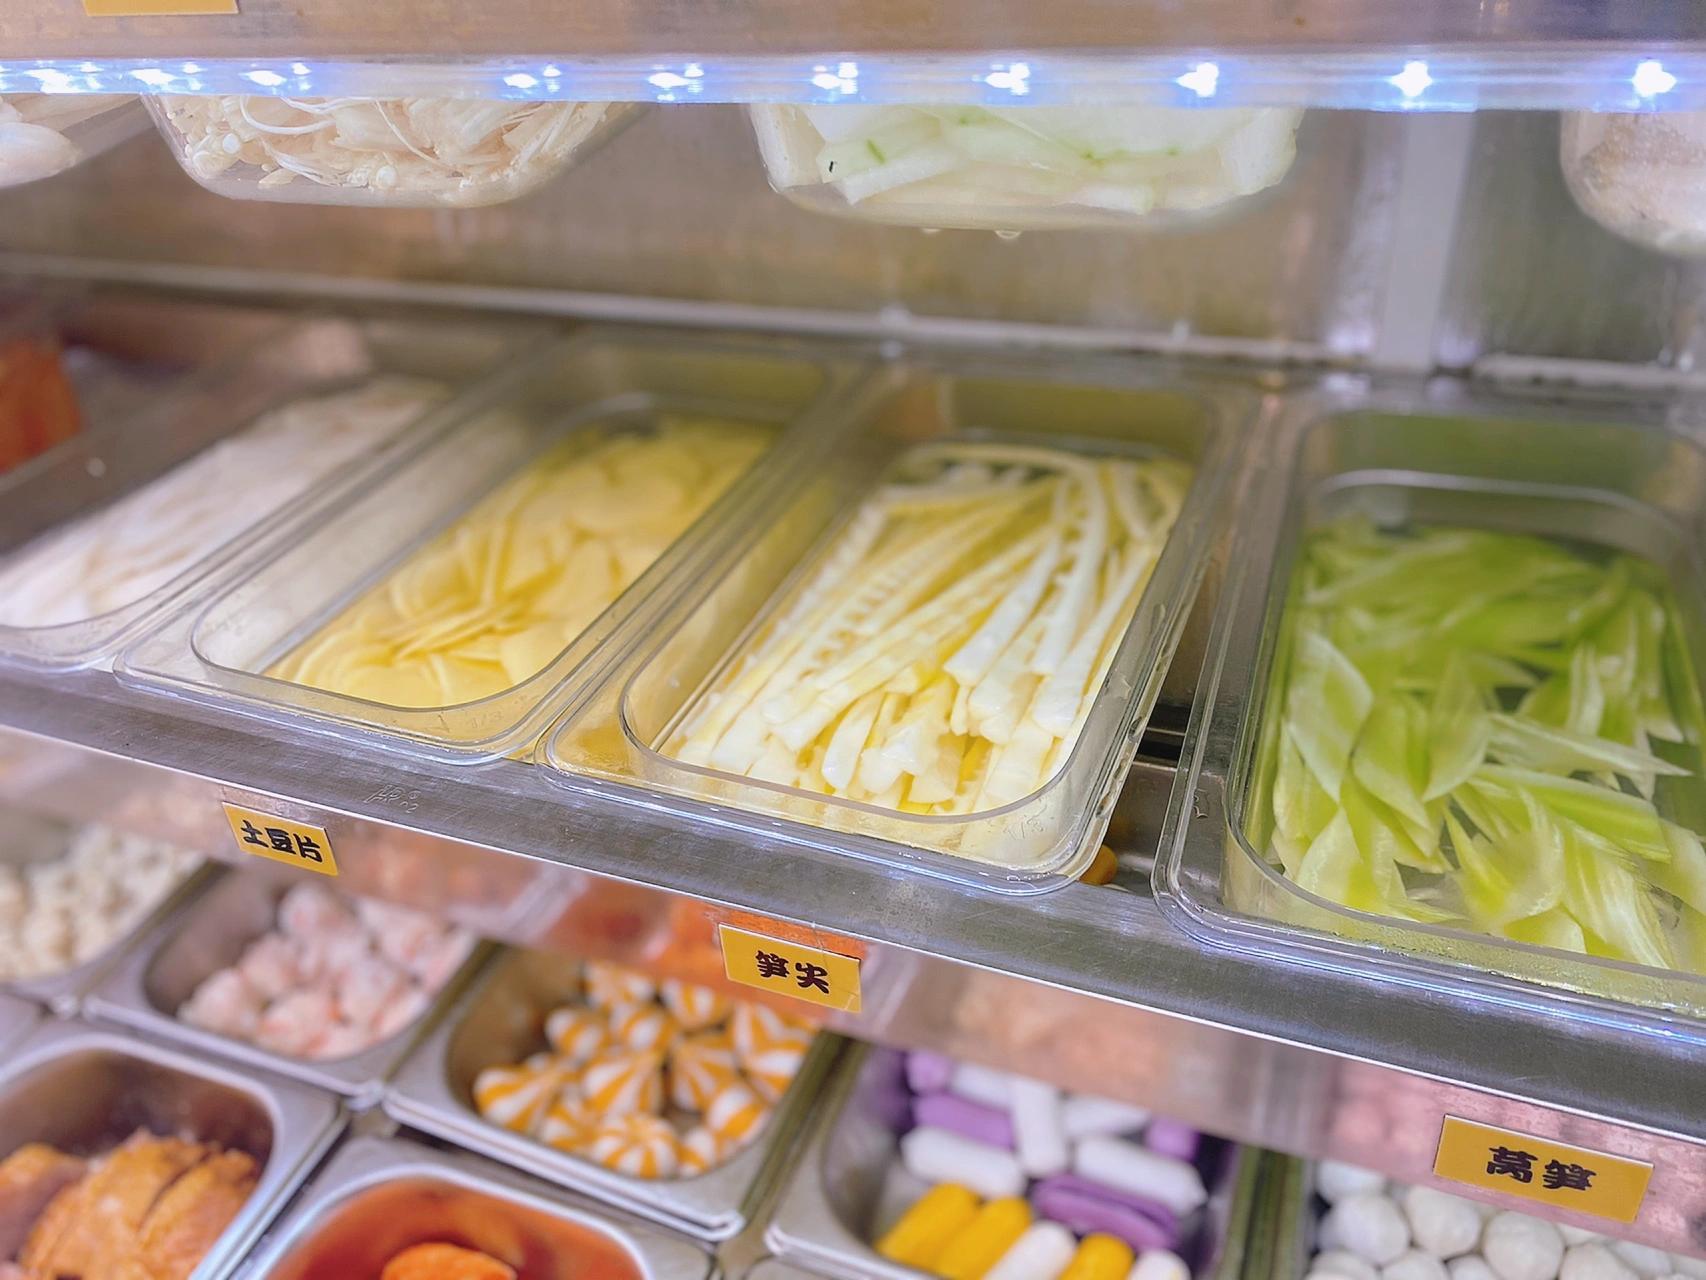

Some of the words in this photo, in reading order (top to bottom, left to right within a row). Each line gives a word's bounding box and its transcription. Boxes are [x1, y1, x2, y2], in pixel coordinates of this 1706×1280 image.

[240, 819, 323, 863] 土豆片
[755, 950, 830, 995] 笋尖
[1486, 1146, 1597, 1191] 莴笋
